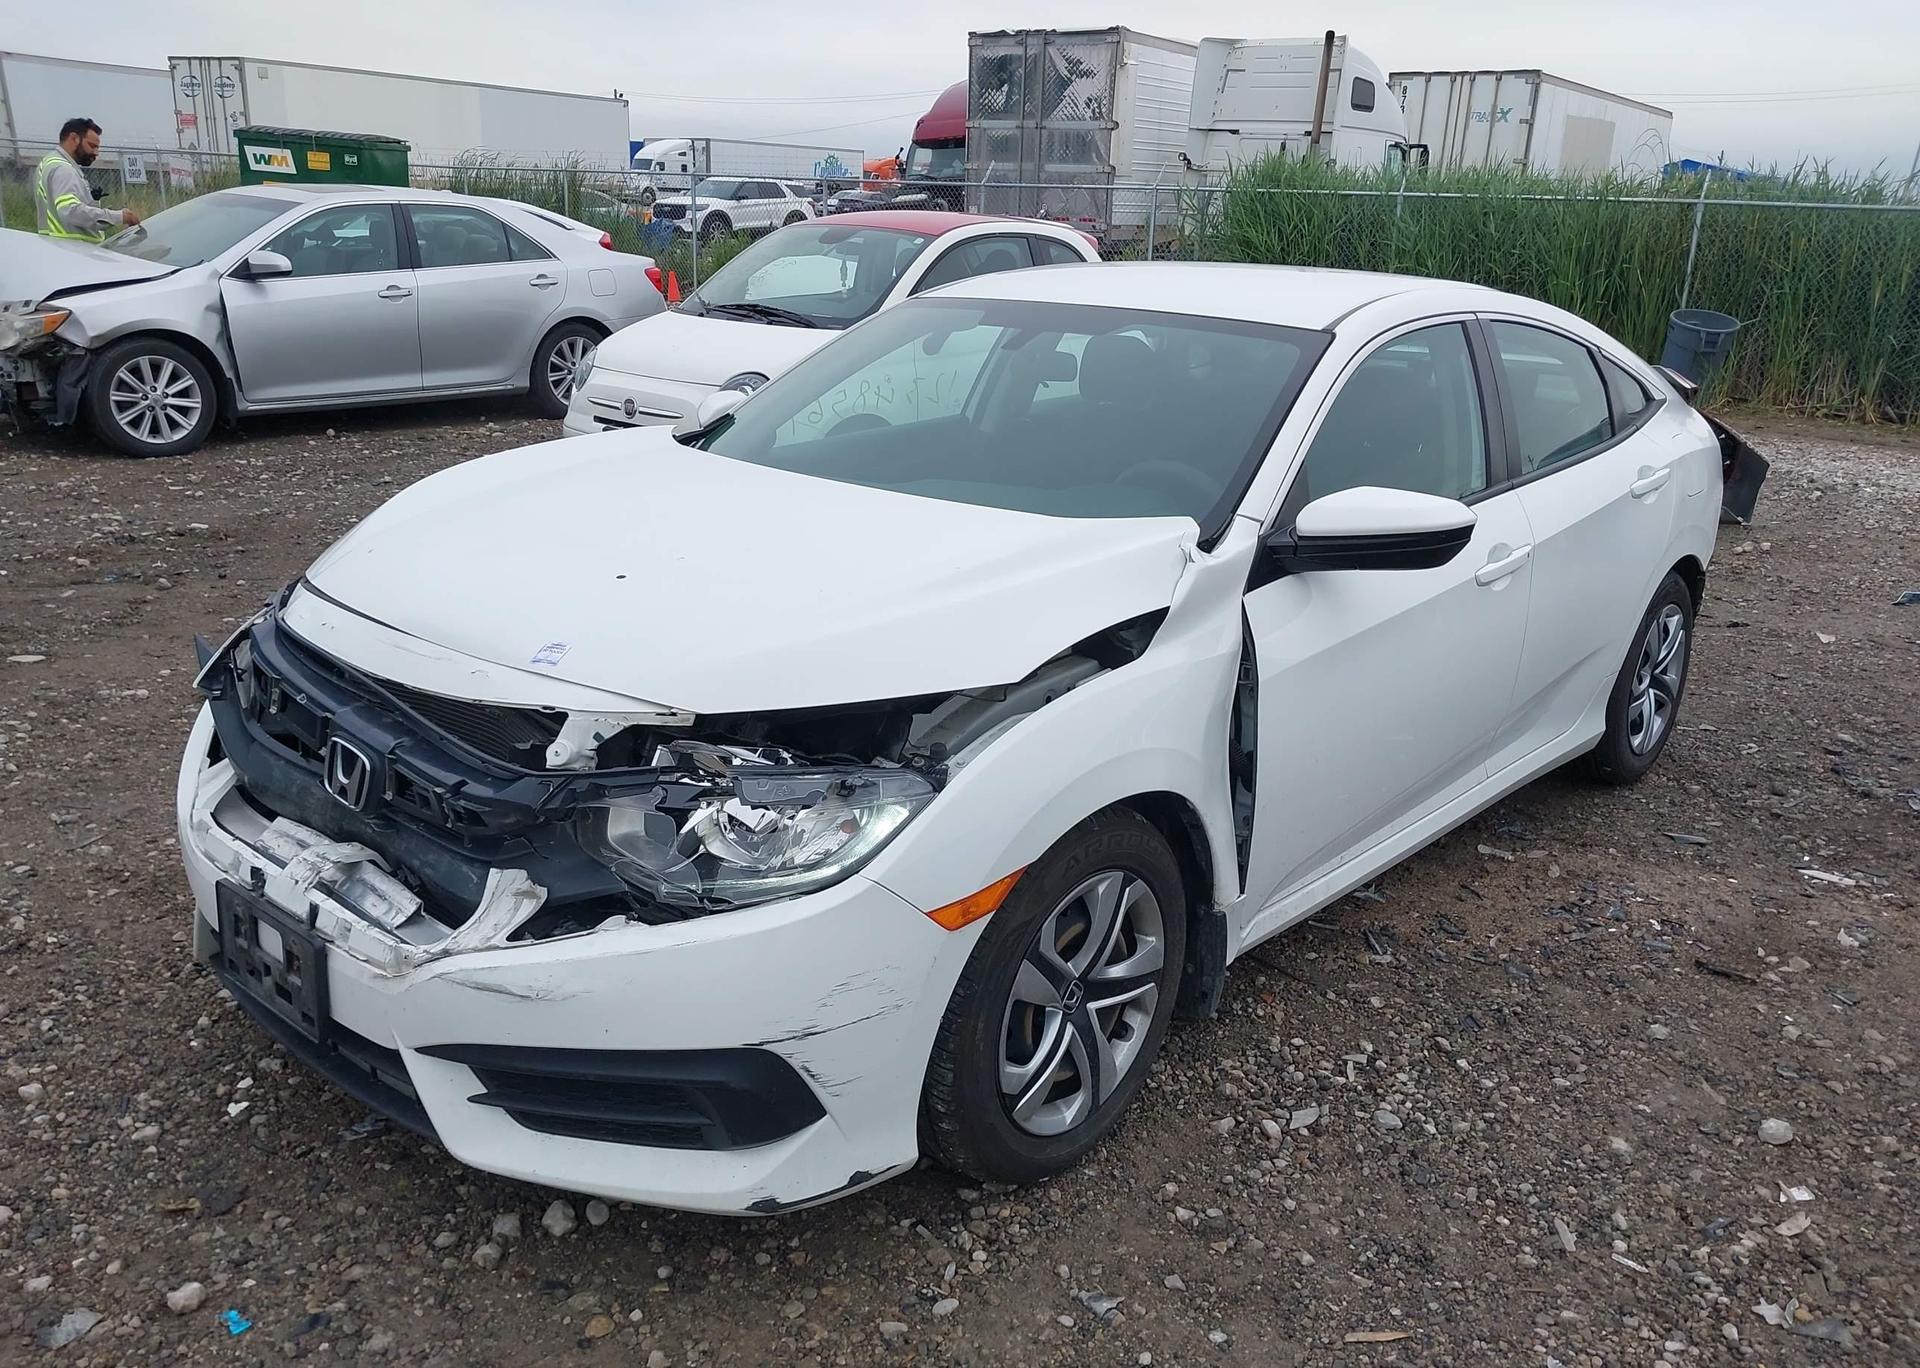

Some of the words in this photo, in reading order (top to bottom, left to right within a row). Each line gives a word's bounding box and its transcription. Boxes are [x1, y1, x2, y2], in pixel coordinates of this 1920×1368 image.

[1471, 107, 1513, 123] TRAX
[128, 157, 138, 167] DAY
[252, 152, 290, 167] WM
[128, 168, 142, 178] DROP
